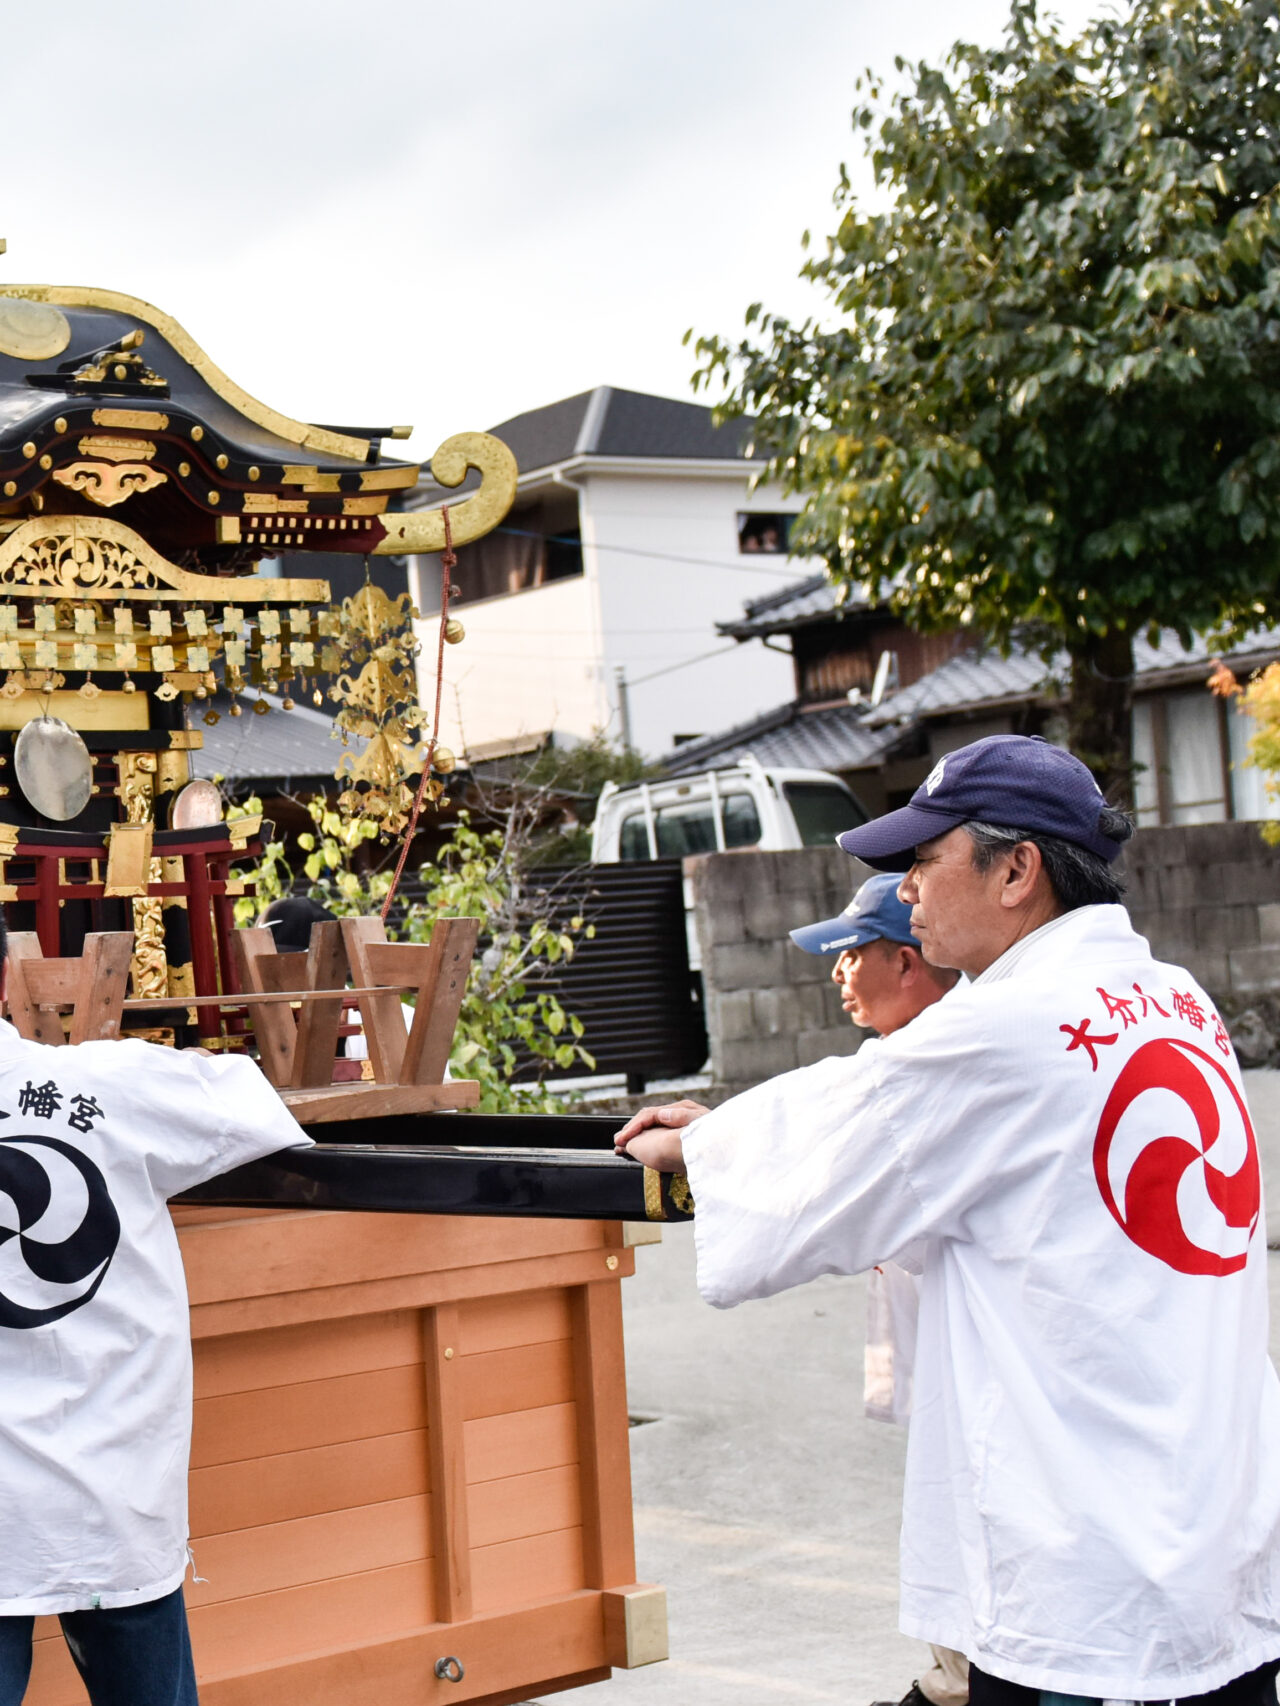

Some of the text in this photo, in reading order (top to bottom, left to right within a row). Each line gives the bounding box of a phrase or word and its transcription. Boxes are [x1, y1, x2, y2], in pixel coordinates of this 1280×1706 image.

[1059, 982, 1232, 1072] 大分八幡宮
